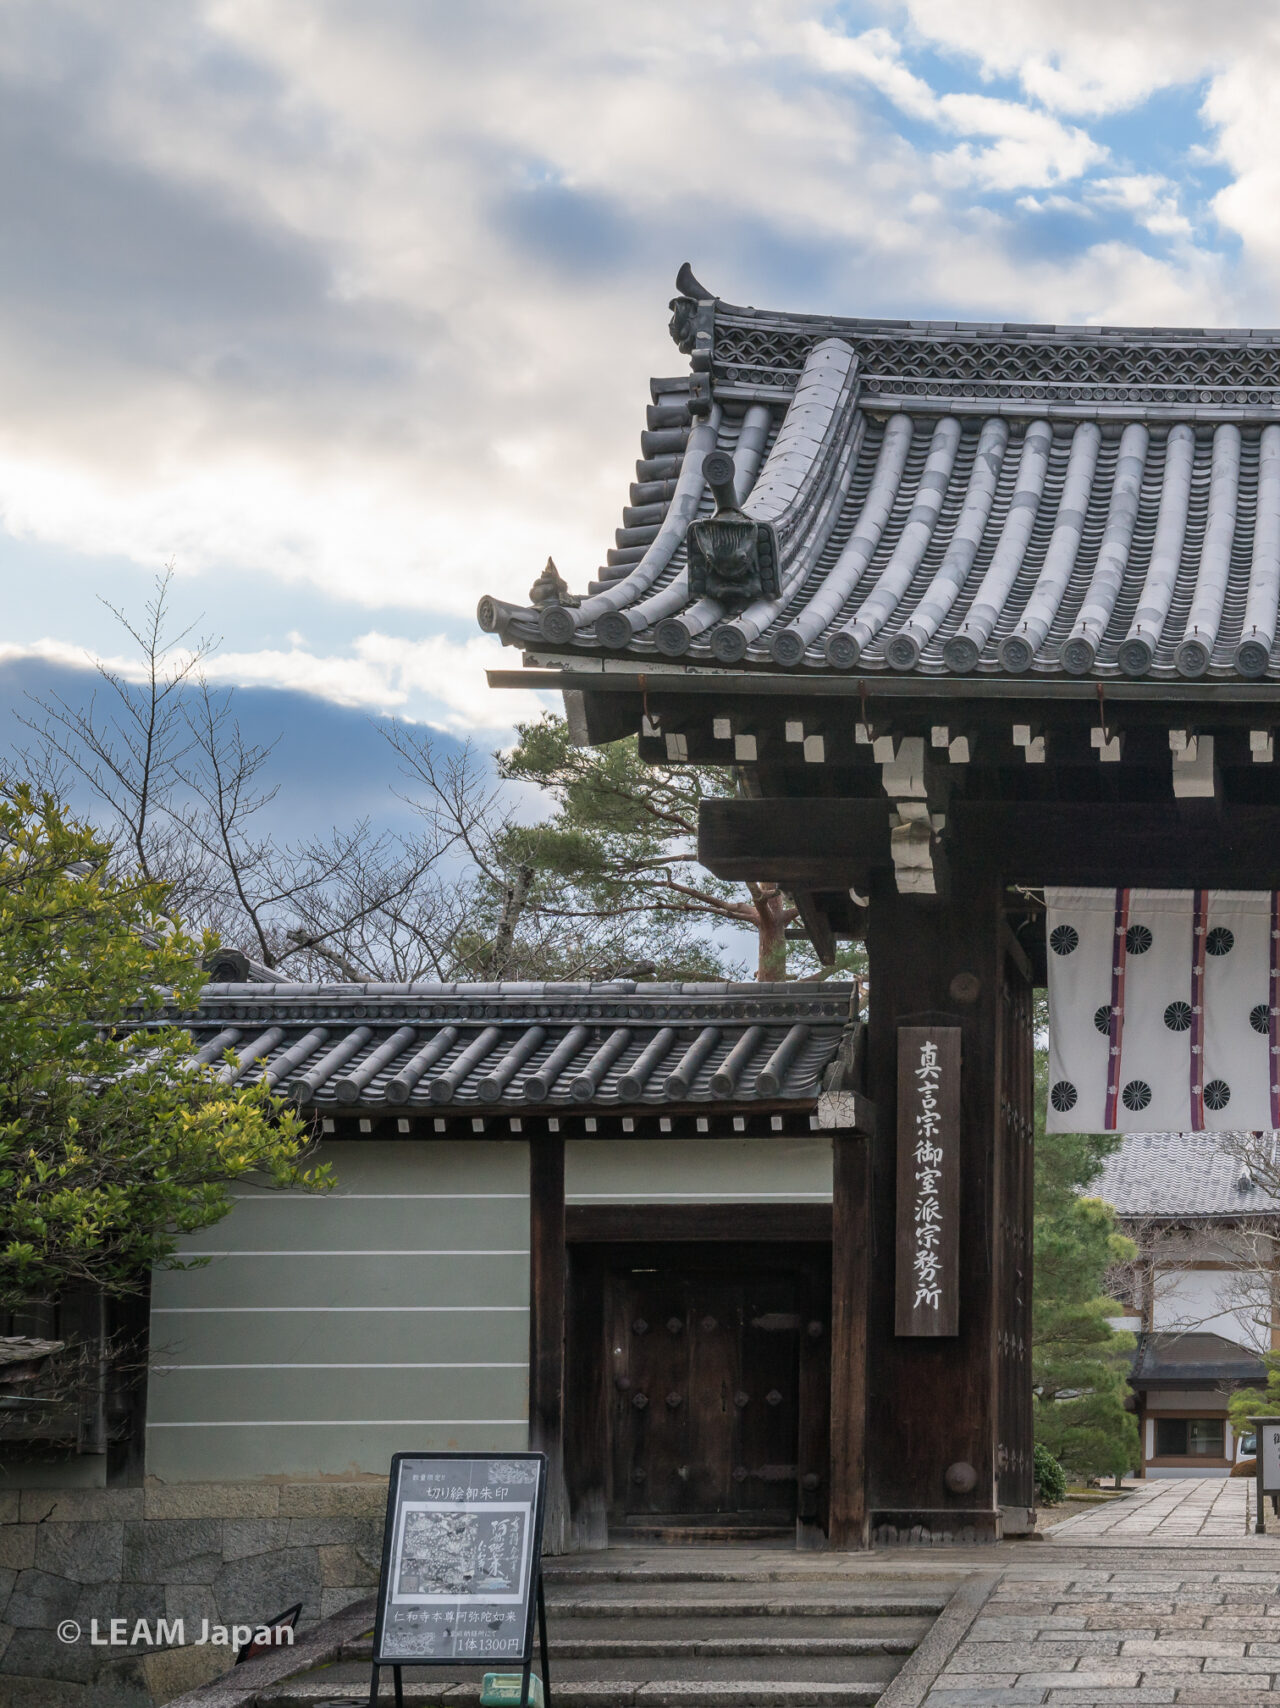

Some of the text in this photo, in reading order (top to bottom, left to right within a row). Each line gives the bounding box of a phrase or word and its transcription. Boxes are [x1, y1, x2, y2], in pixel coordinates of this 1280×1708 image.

[911, 1040, 944, 1311] 真言宗御室派宗務所
[426, 1486, 509, 1500] 切り絵御朱印
[394, 1610, 517, 1622] 仁和寺本尊阿弥陀如来
[457, 1638, 519, 1651] 1体1300円
